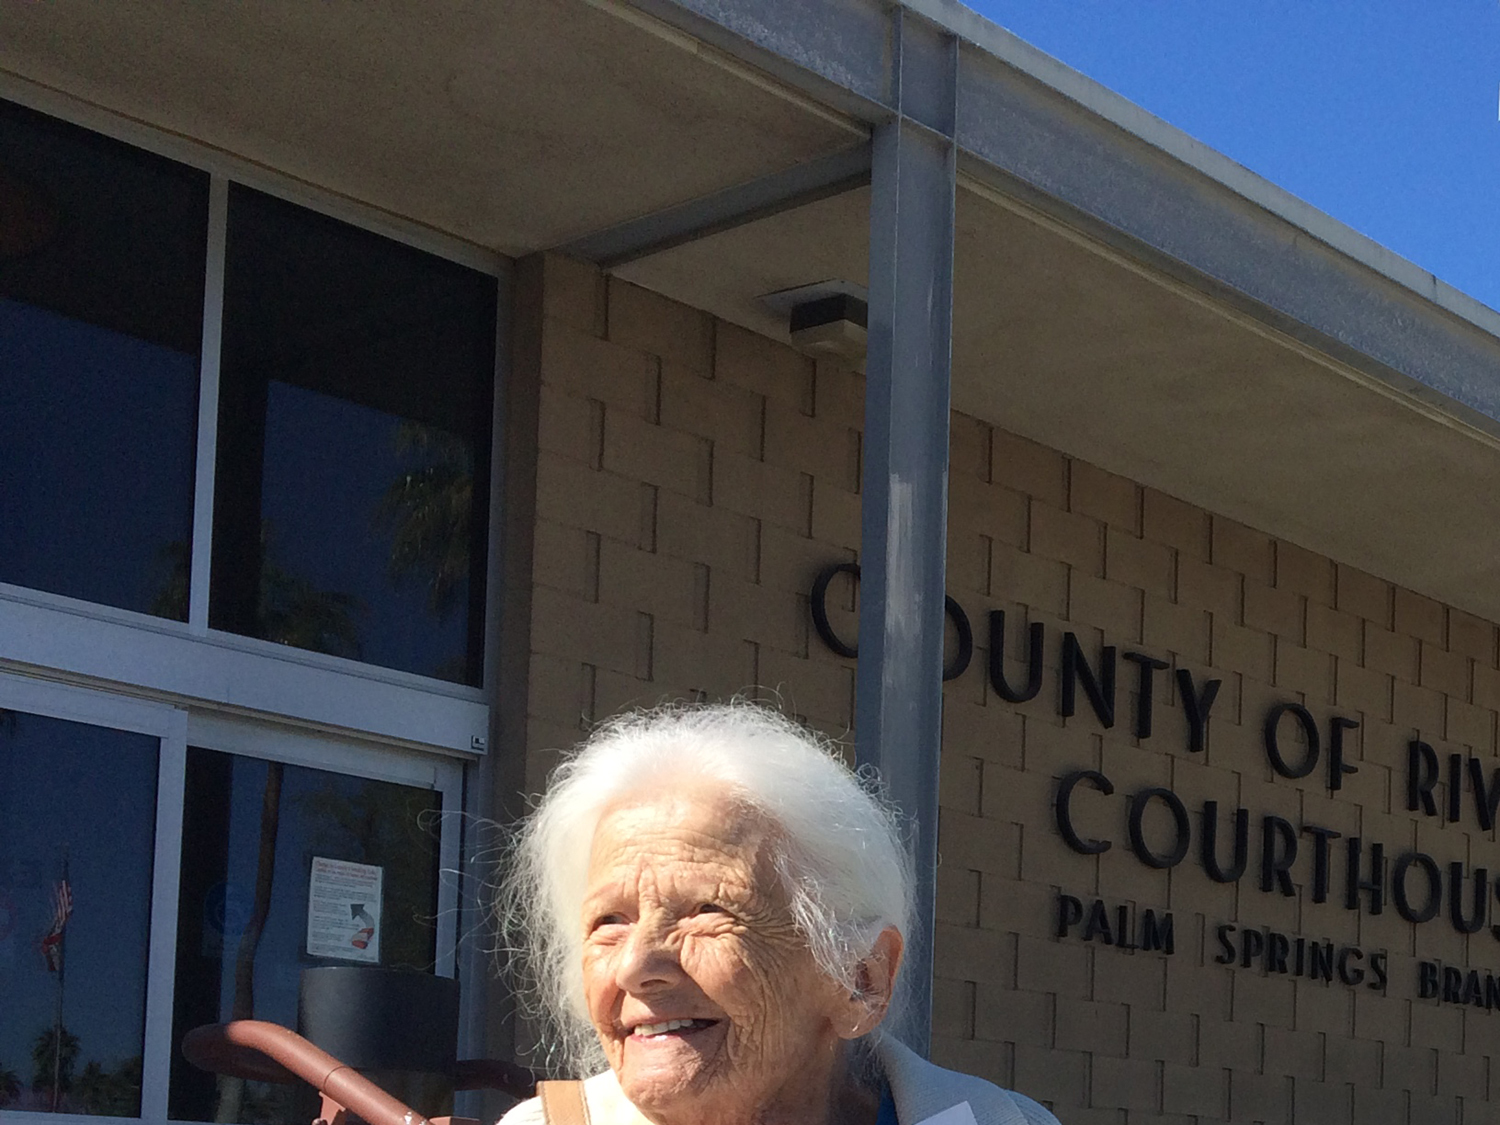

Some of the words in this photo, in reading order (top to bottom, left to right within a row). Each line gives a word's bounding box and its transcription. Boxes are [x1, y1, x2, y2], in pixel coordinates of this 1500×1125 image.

[1264, 702, 1360, 791] OF
[1056, 894, 1176, 955] PALM
[1215, 922, 1388, 991] SPRINGS
